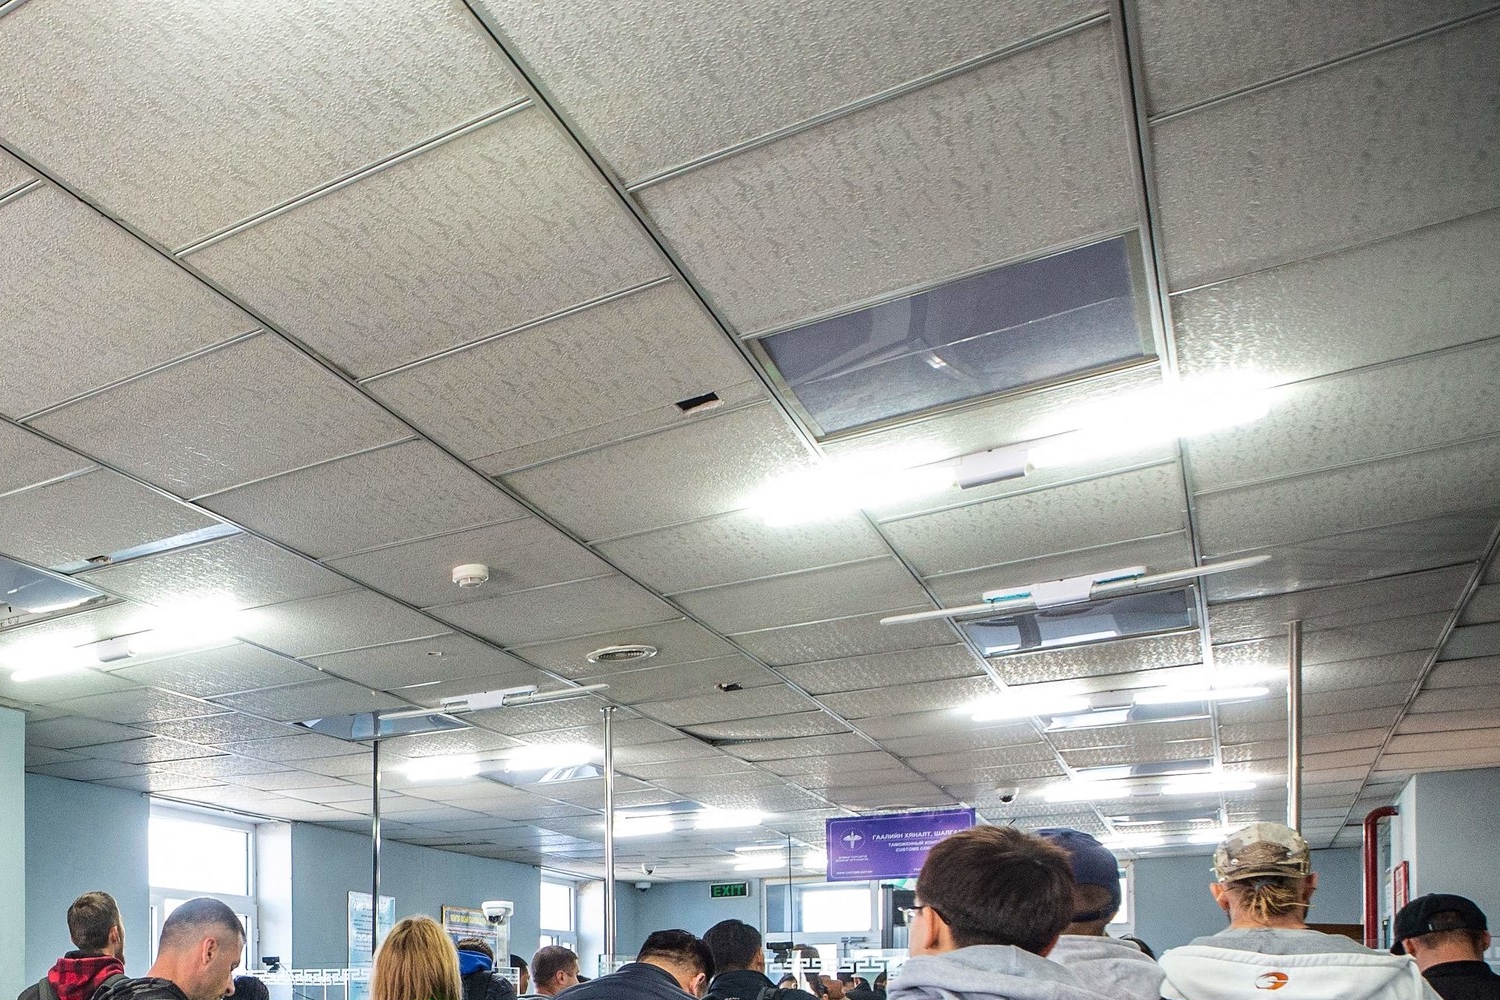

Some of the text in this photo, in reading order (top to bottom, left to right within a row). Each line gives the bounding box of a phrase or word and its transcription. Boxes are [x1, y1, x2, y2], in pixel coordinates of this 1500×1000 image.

[872, 833, 904, 841] ГААЛИЙН
[904, 831, 933, 839] ХЯНАЛТ,
[713, 885, 744, 897] EXIT
